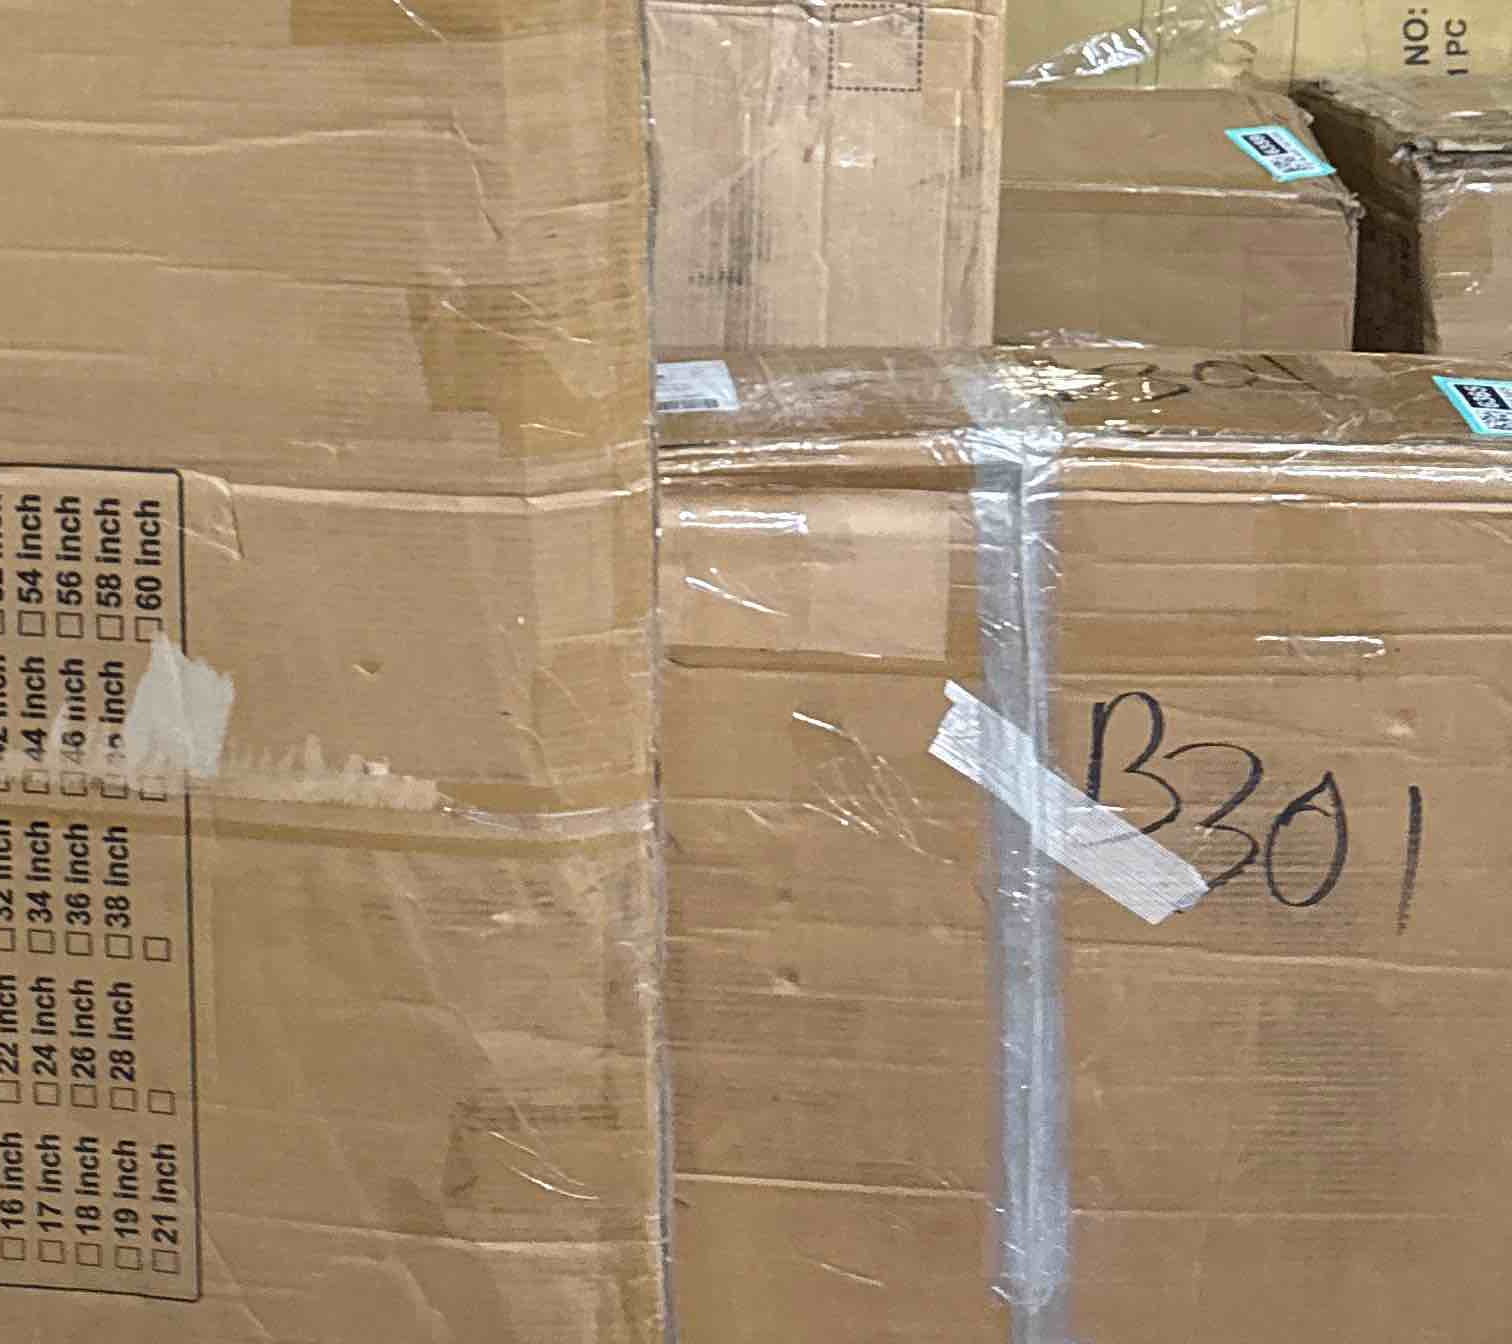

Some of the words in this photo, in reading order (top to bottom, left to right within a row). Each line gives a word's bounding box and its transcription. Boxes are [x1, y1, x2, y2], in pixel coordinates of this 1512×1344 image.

[1402, 7, 1431, 66] NO:
[1444, 17, 1469, 56] PC
[13, 493, 43, 561] inch
[53, 495, 83, 562] inch
[92, 497, 123, 564] inch
[132, 499, 163, 566] inch
[15, 567, 44, 605] 54
[55, 570, 83, 606] 56
[95, 573, 123, 609] 58
[134, 575, 163, 611] 60
[18, 655, 48, 720] inch
[97, 660, 127, 725] inch
[20, 727, 49, 765] 44
[23, 820, 52, 883] inch
[62, 823, 92, 884] inch
[101, 825, 131, 887] inch
[25, 890, 54, 924] 34
[64, 892, 93, 926] 36
[103, 895, 132, 929] 38
[27, 976, 58, 1036] inch
[67, 978, 96, 1039] inch
[106, 981, 135, 1041] inch
[31, 1043, 58, 1077] 24
[69, 1046, 97, 1080] 26
[108, 1049, 137, 1083] 28
[34, 1134, 63, 1194] inch
[72, 1136, 101, 1197] inch
[111, 1139, 139, 1201] inch
[150, 1143, 178, 1204] inch
[36, 1201, 65, 1233] 17
[74, 1205, 102, 1236] 18
[112, 1207, 140, 1239] 19
[151, 1213, 179, 1245] 21
